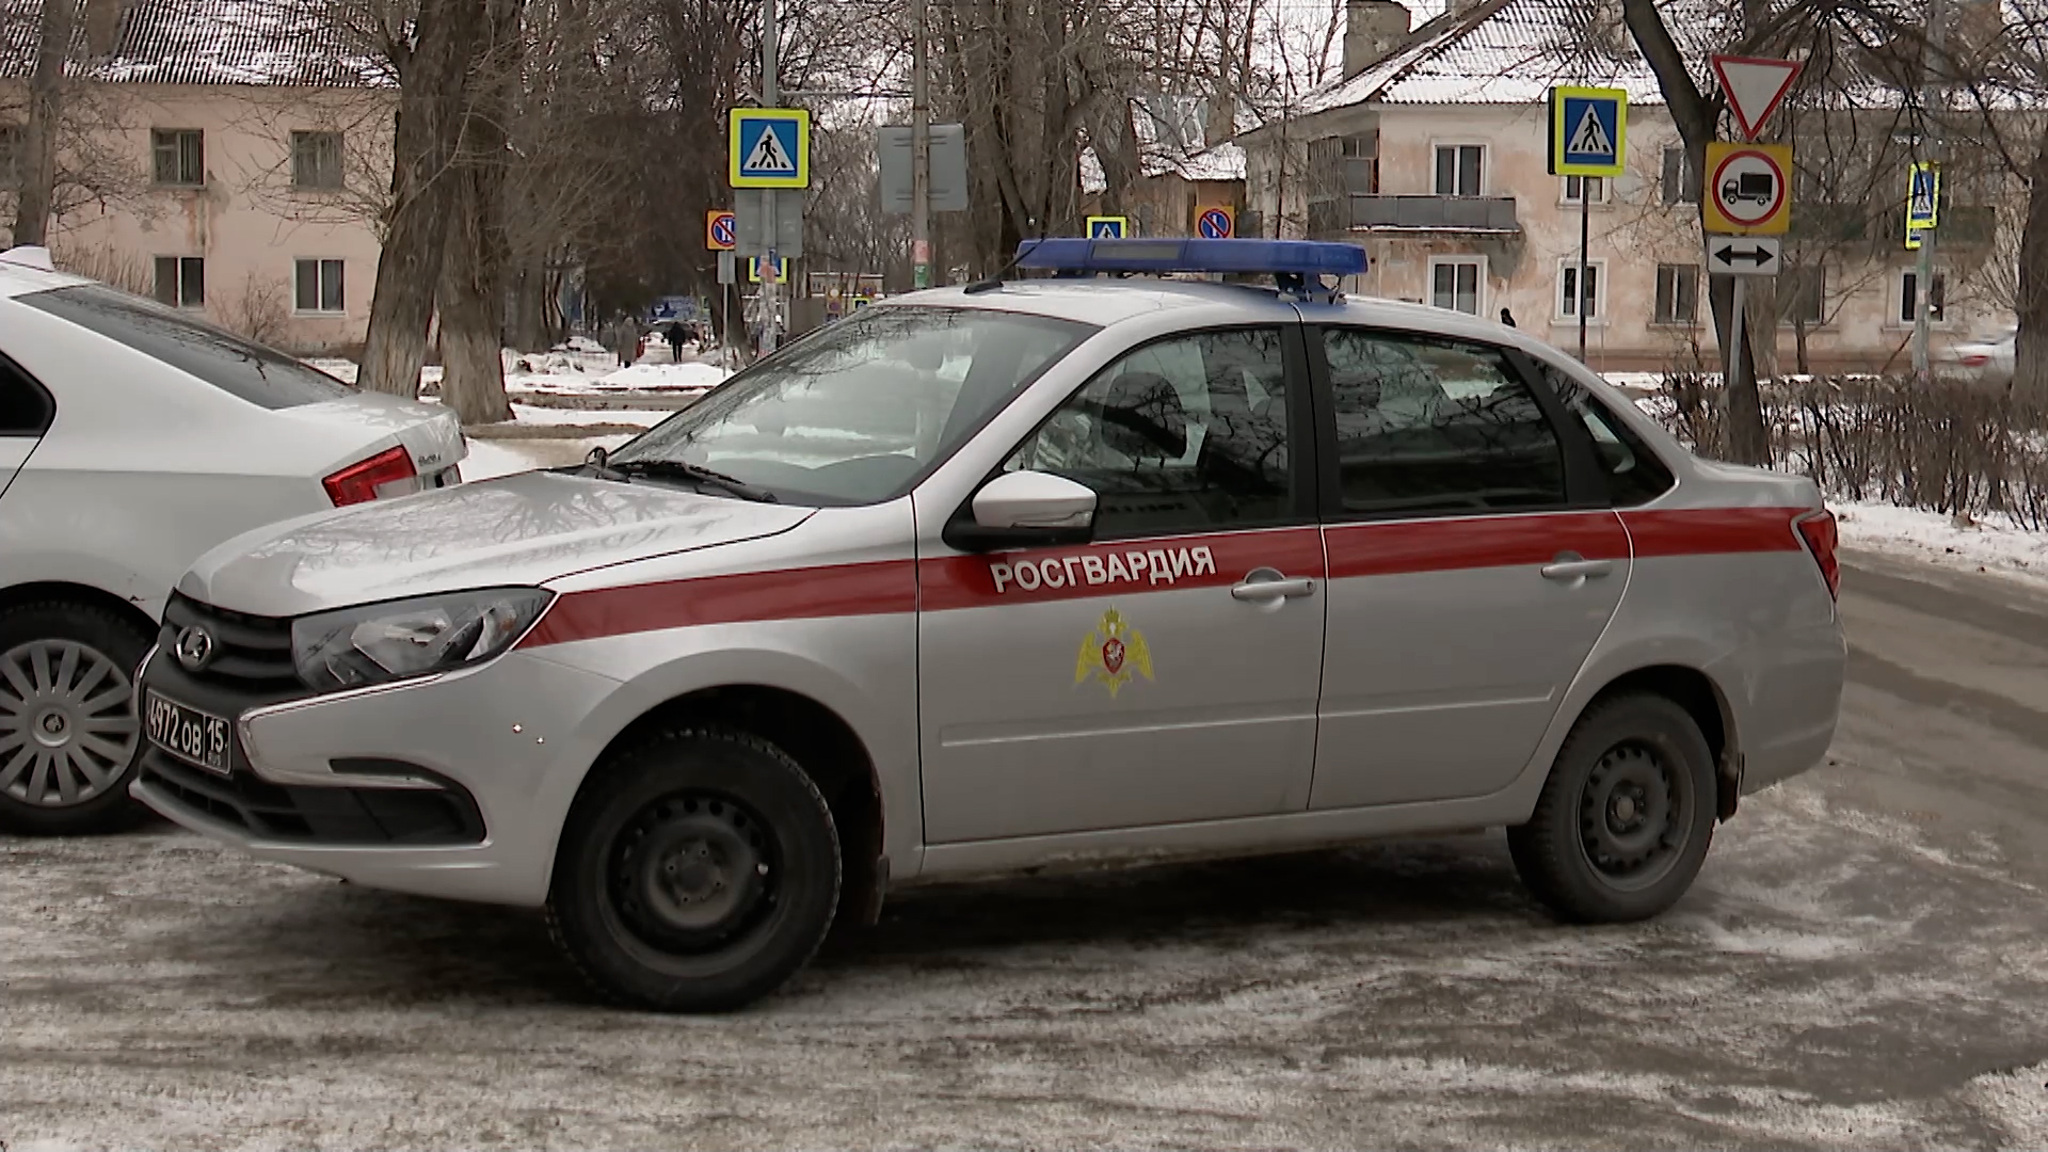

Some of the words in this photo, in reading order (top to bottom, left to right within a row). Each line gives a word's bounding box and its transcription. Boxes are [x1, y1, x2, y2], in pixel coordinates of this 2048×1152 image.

[989, 546, 1216, 593] РОСГВАРДИЯ
[150, 698, 179, 749] 4972
[207, 720, 224, 753] 15
